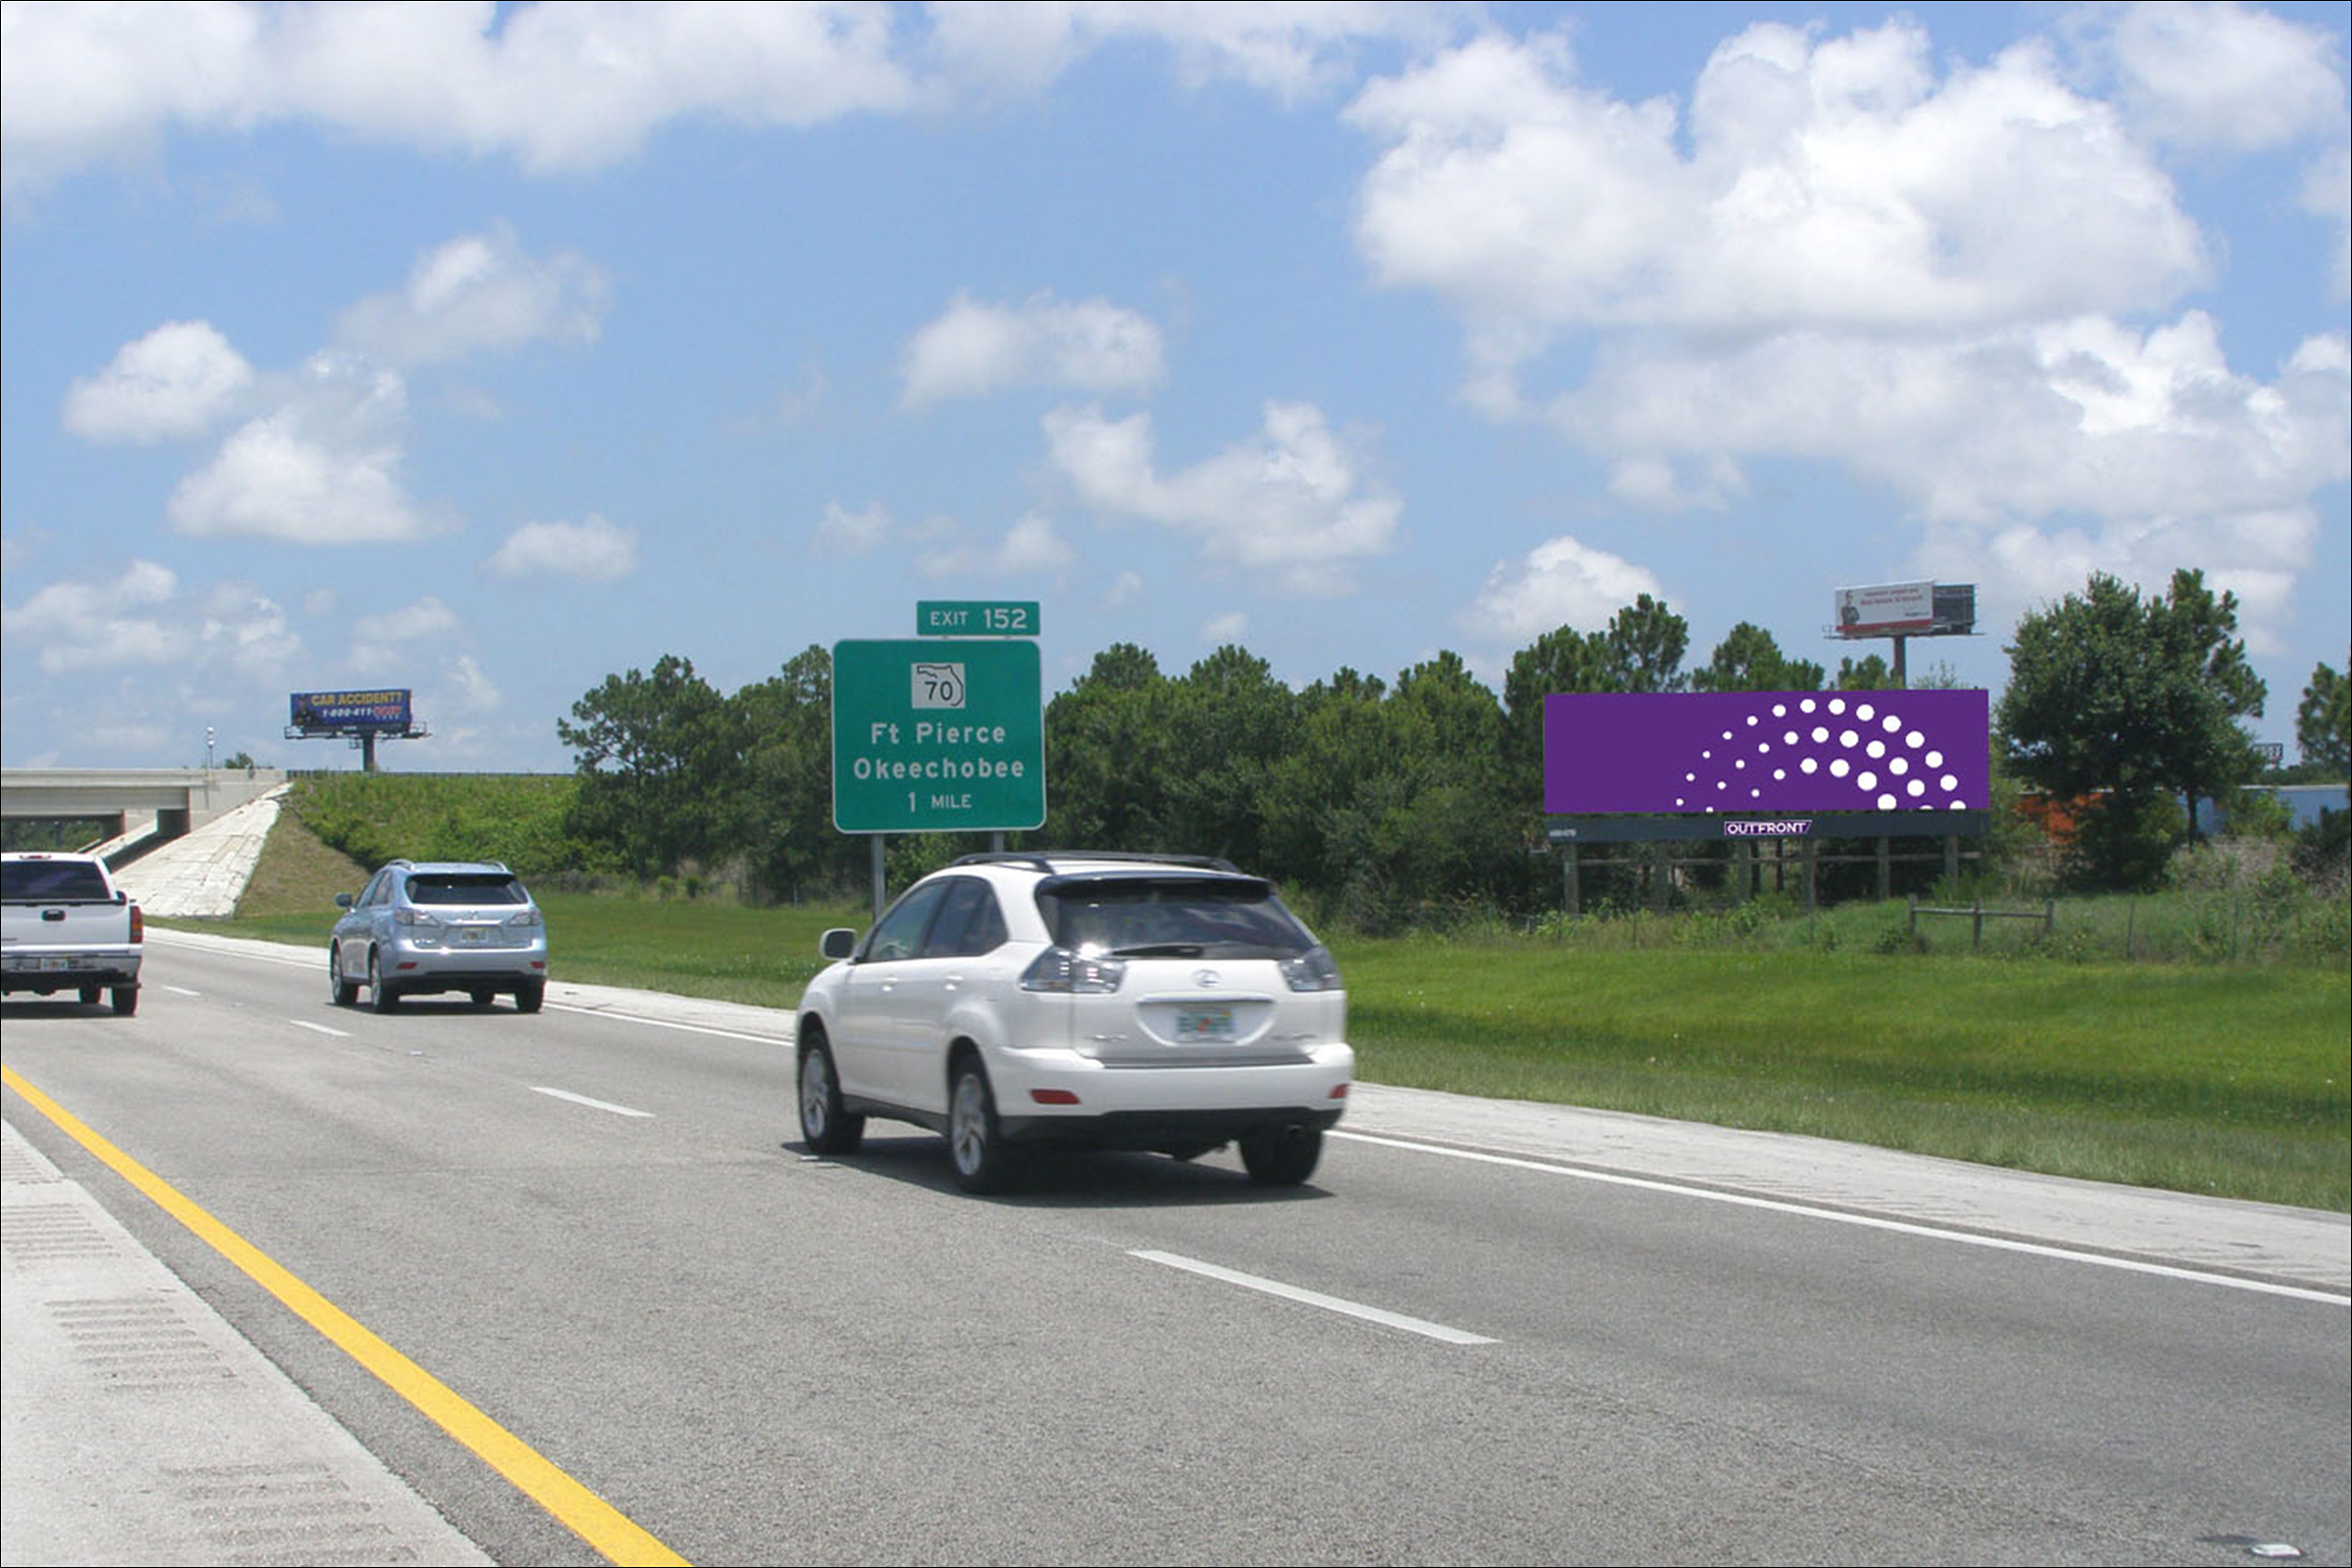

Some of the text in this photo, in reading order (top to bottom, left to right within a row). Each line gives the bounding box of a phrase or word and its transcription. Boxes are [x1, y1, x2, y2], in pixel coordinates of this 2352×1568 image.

[930, 608, 1028, 628] EXIT 152
[312, 695, 335, 706] CAR
[924, 681, 954, 701] 70
[871, 722, 1006, 744] Ft Pierce
[854, 758, 1025, 779] Okeechobee
[908, 792, 972, 812] 1 MILE
[1727, 822, 1806, 834] OUTFRONT
